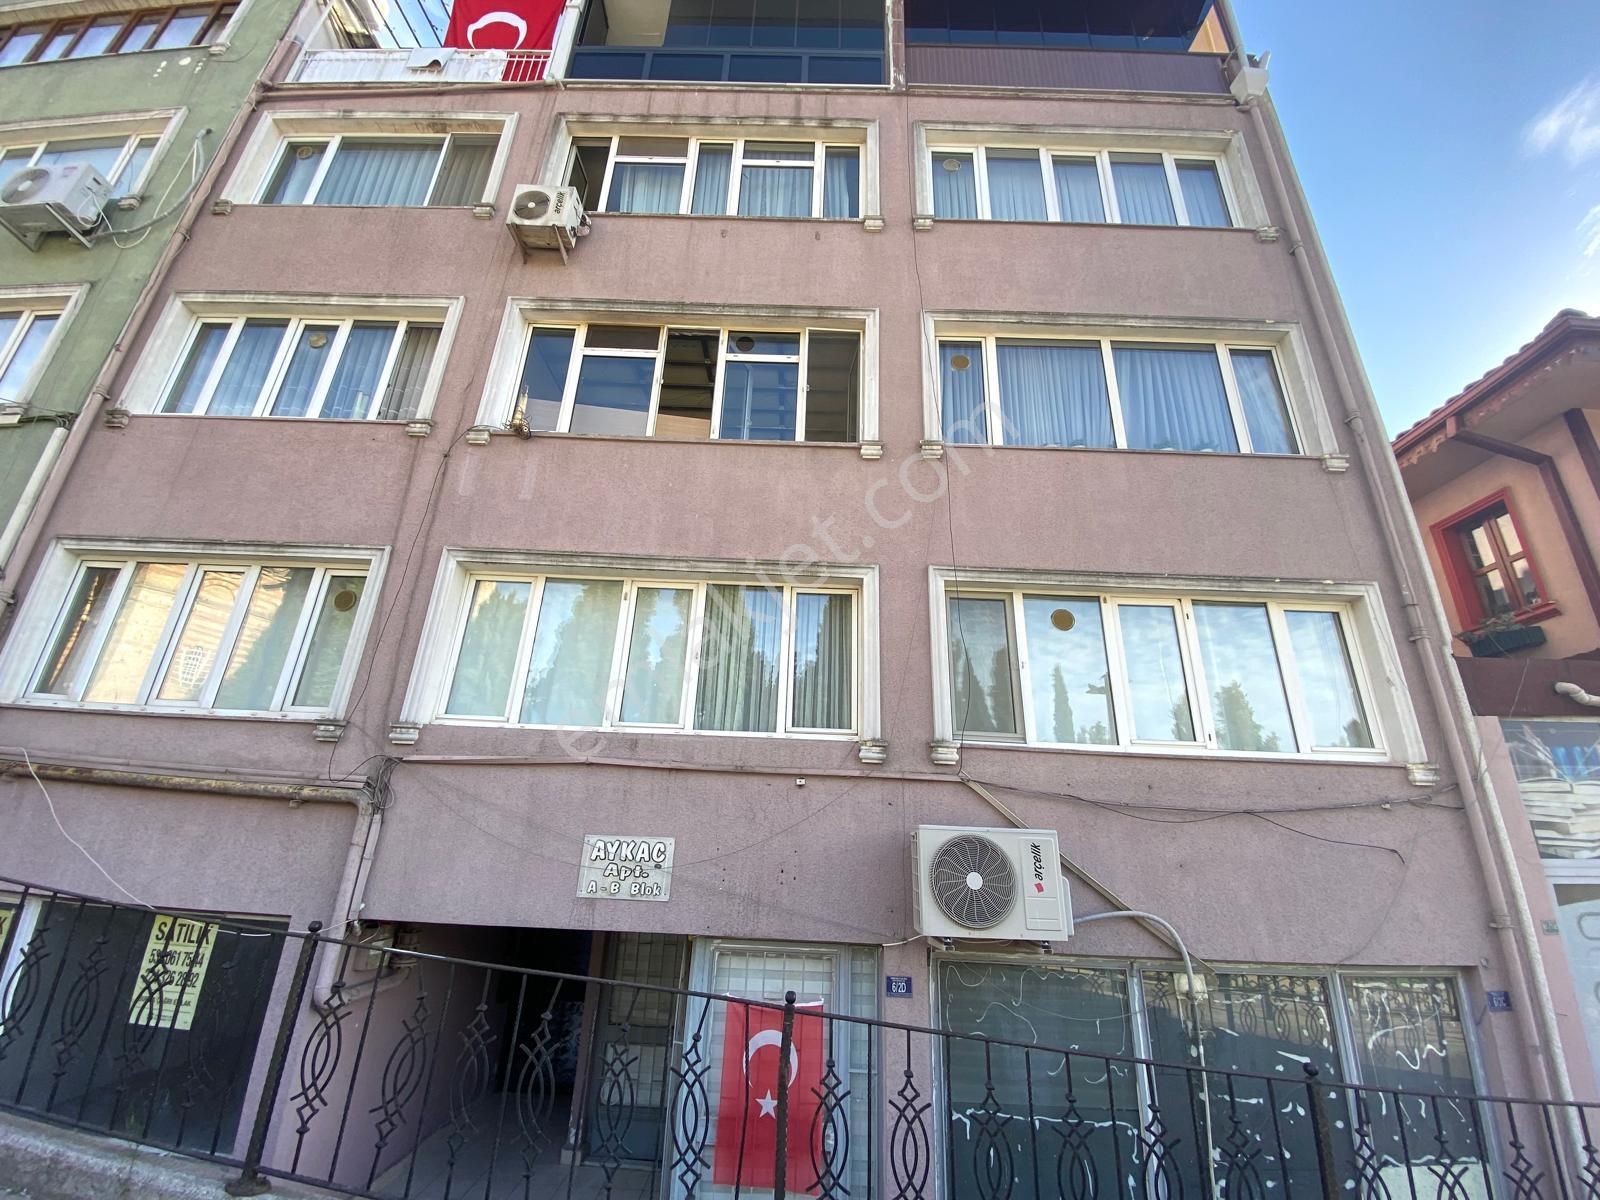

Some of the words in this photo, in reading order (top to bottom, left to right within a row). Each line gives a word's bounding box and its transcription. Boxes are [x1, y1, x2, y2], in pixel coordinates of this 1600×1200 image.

[1030, 842, 1045, 881] arçelik
[603, 862, 650, 881] Apt.
[630, 881, 662, 897] Blok
